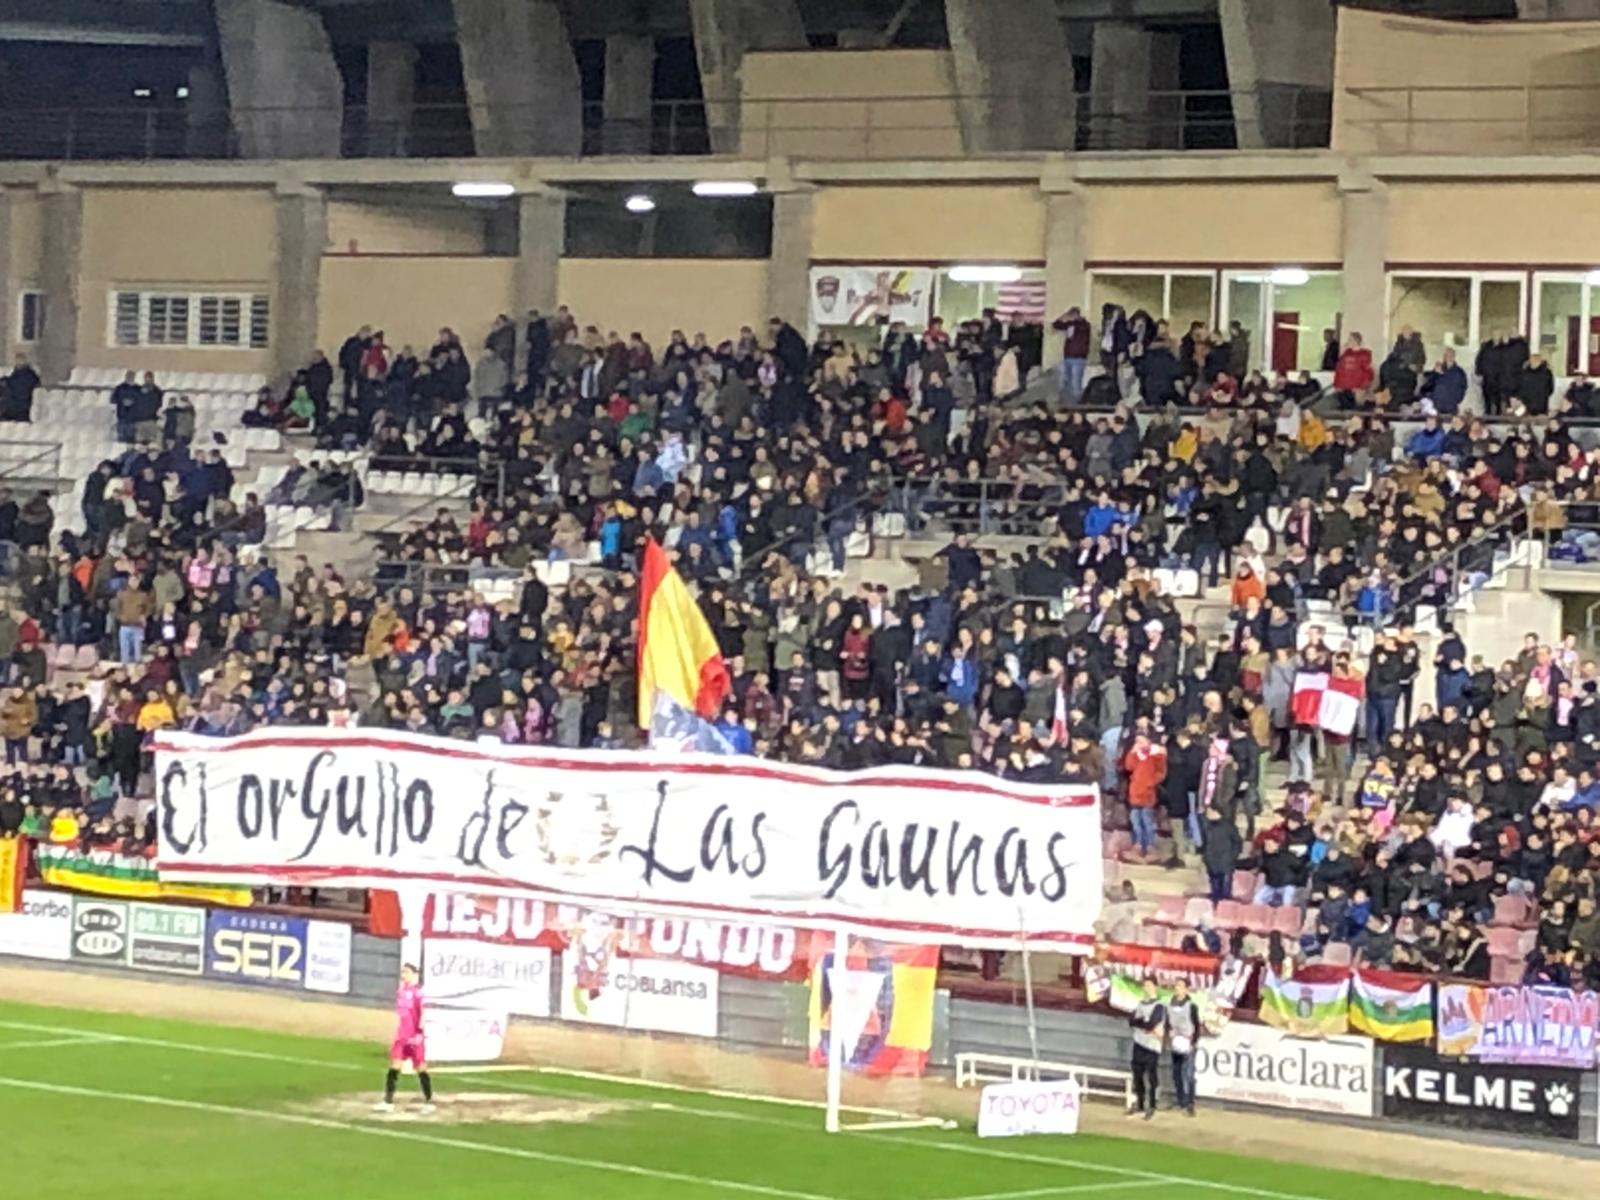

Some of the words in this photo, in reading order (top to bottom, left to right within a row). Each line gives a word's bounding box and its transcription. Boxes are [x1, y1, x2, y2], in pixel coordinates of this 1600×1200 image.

[161, 758, 209, 856] El
[455, 768, 530, 872] de
[619, 778, 767, 886] Las
[817, 799, 1075, 902] Gaunas
[212, 928, 302, 981] SER
[987, 1090, 1076, 1118] TOYOTA
[1384, 1065, 1536, 1113] KELME
